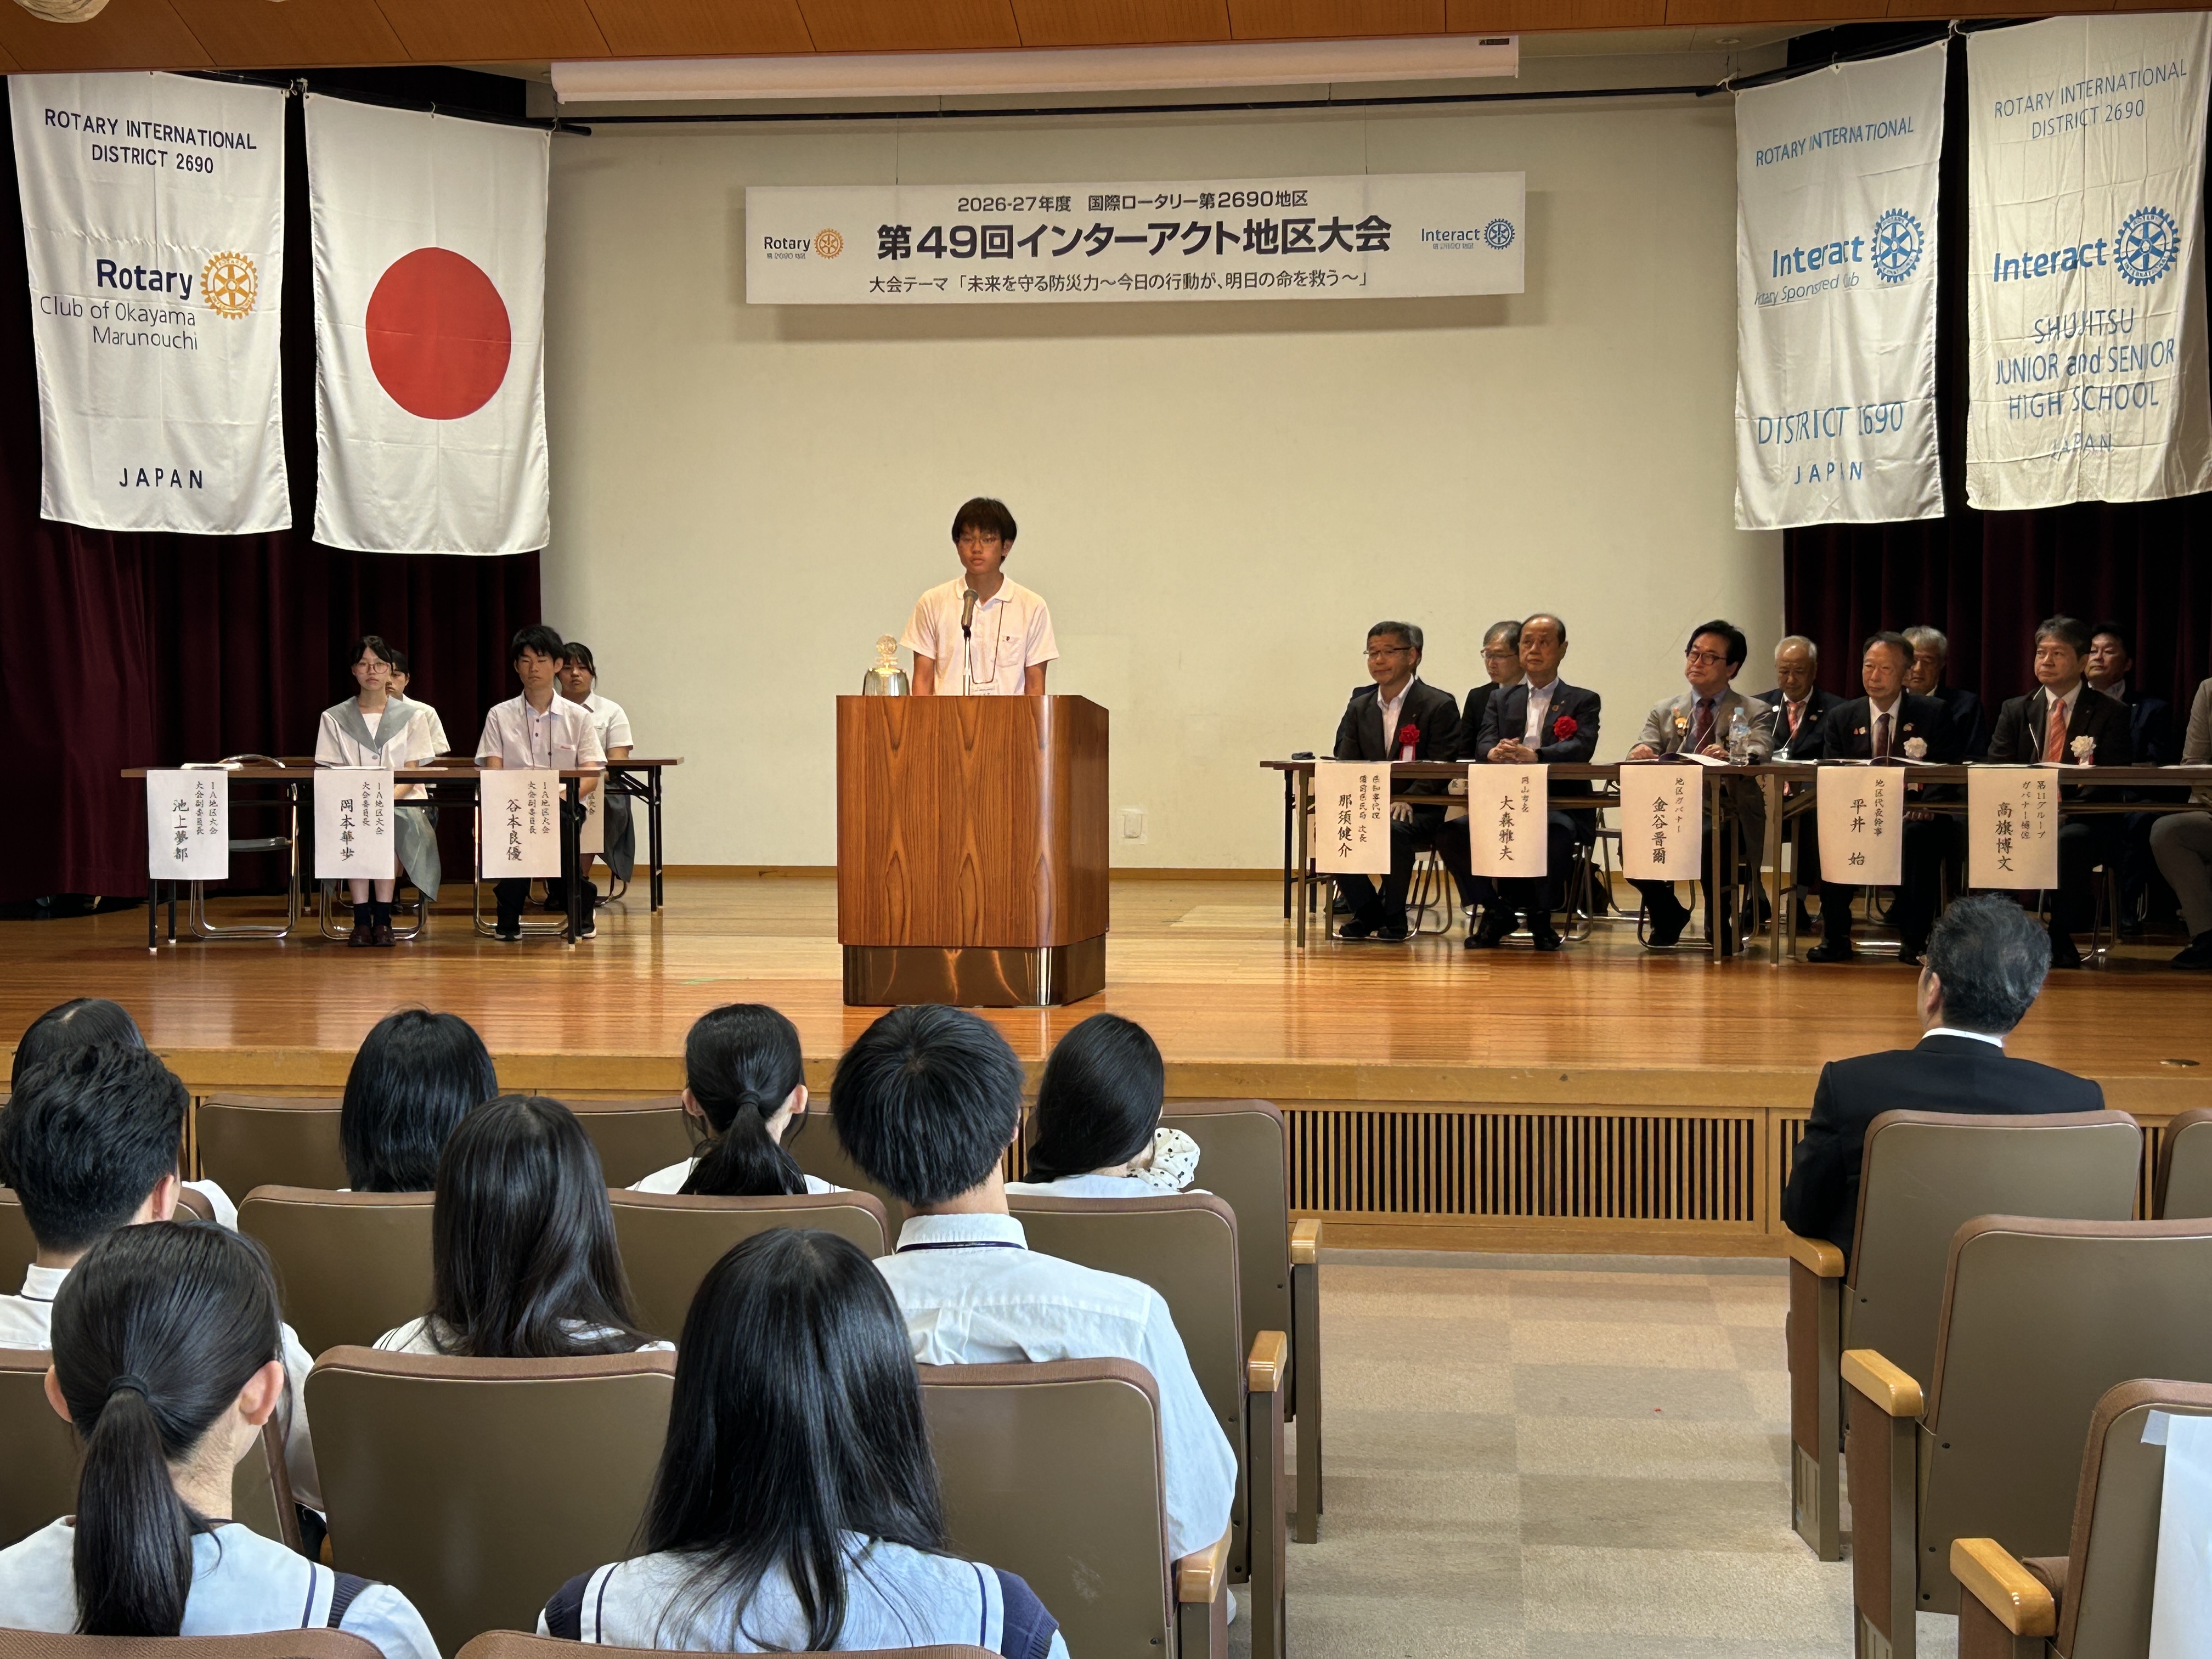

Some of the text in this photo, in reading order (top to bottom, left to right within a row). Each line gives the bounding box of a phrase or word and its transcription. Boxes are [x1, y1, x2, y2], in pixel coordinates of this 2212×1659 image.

[1995, 59, 2187, 119] ROTARY INTERNATIONAL
[45, 109, 257, 150] ROTARY INTERNATIONAL
[2032, 99, 2144, 139] DISTRICT 2690
[92, 144, 213, 173] DISTRICT 2690
[1756, 116, 1914, 167] ROTARY INTERNATIONAL
[958, 190, 1308, 213] 2026-27年度 国際ロータリー第2690地区
[764, 236, 810, 251] Rotary
[877, 215, 1392, 261] 第49回インターアクト地区大会
[1421, 228, 1480, 241] Interact
[97, 259, 193, 300] Rotary
[1994, 238, 2107, 282] Interact
[40, 296, 195, 327] Club of Okayama
[2034, 308, 2134, 343] SHUJITSU
[93, 326, 198, 349] Marunouchi
[1996, 338, 2174, 385] JUNIOR and SENIOR
[2010, 381, 2158, 420] HIGH SCHOOL
[120, 468, 202, 489] JAPAN
[1338, 794, 1352, 857] 那須健介
[1499, 795, 1515, 861] 大森雅夫
